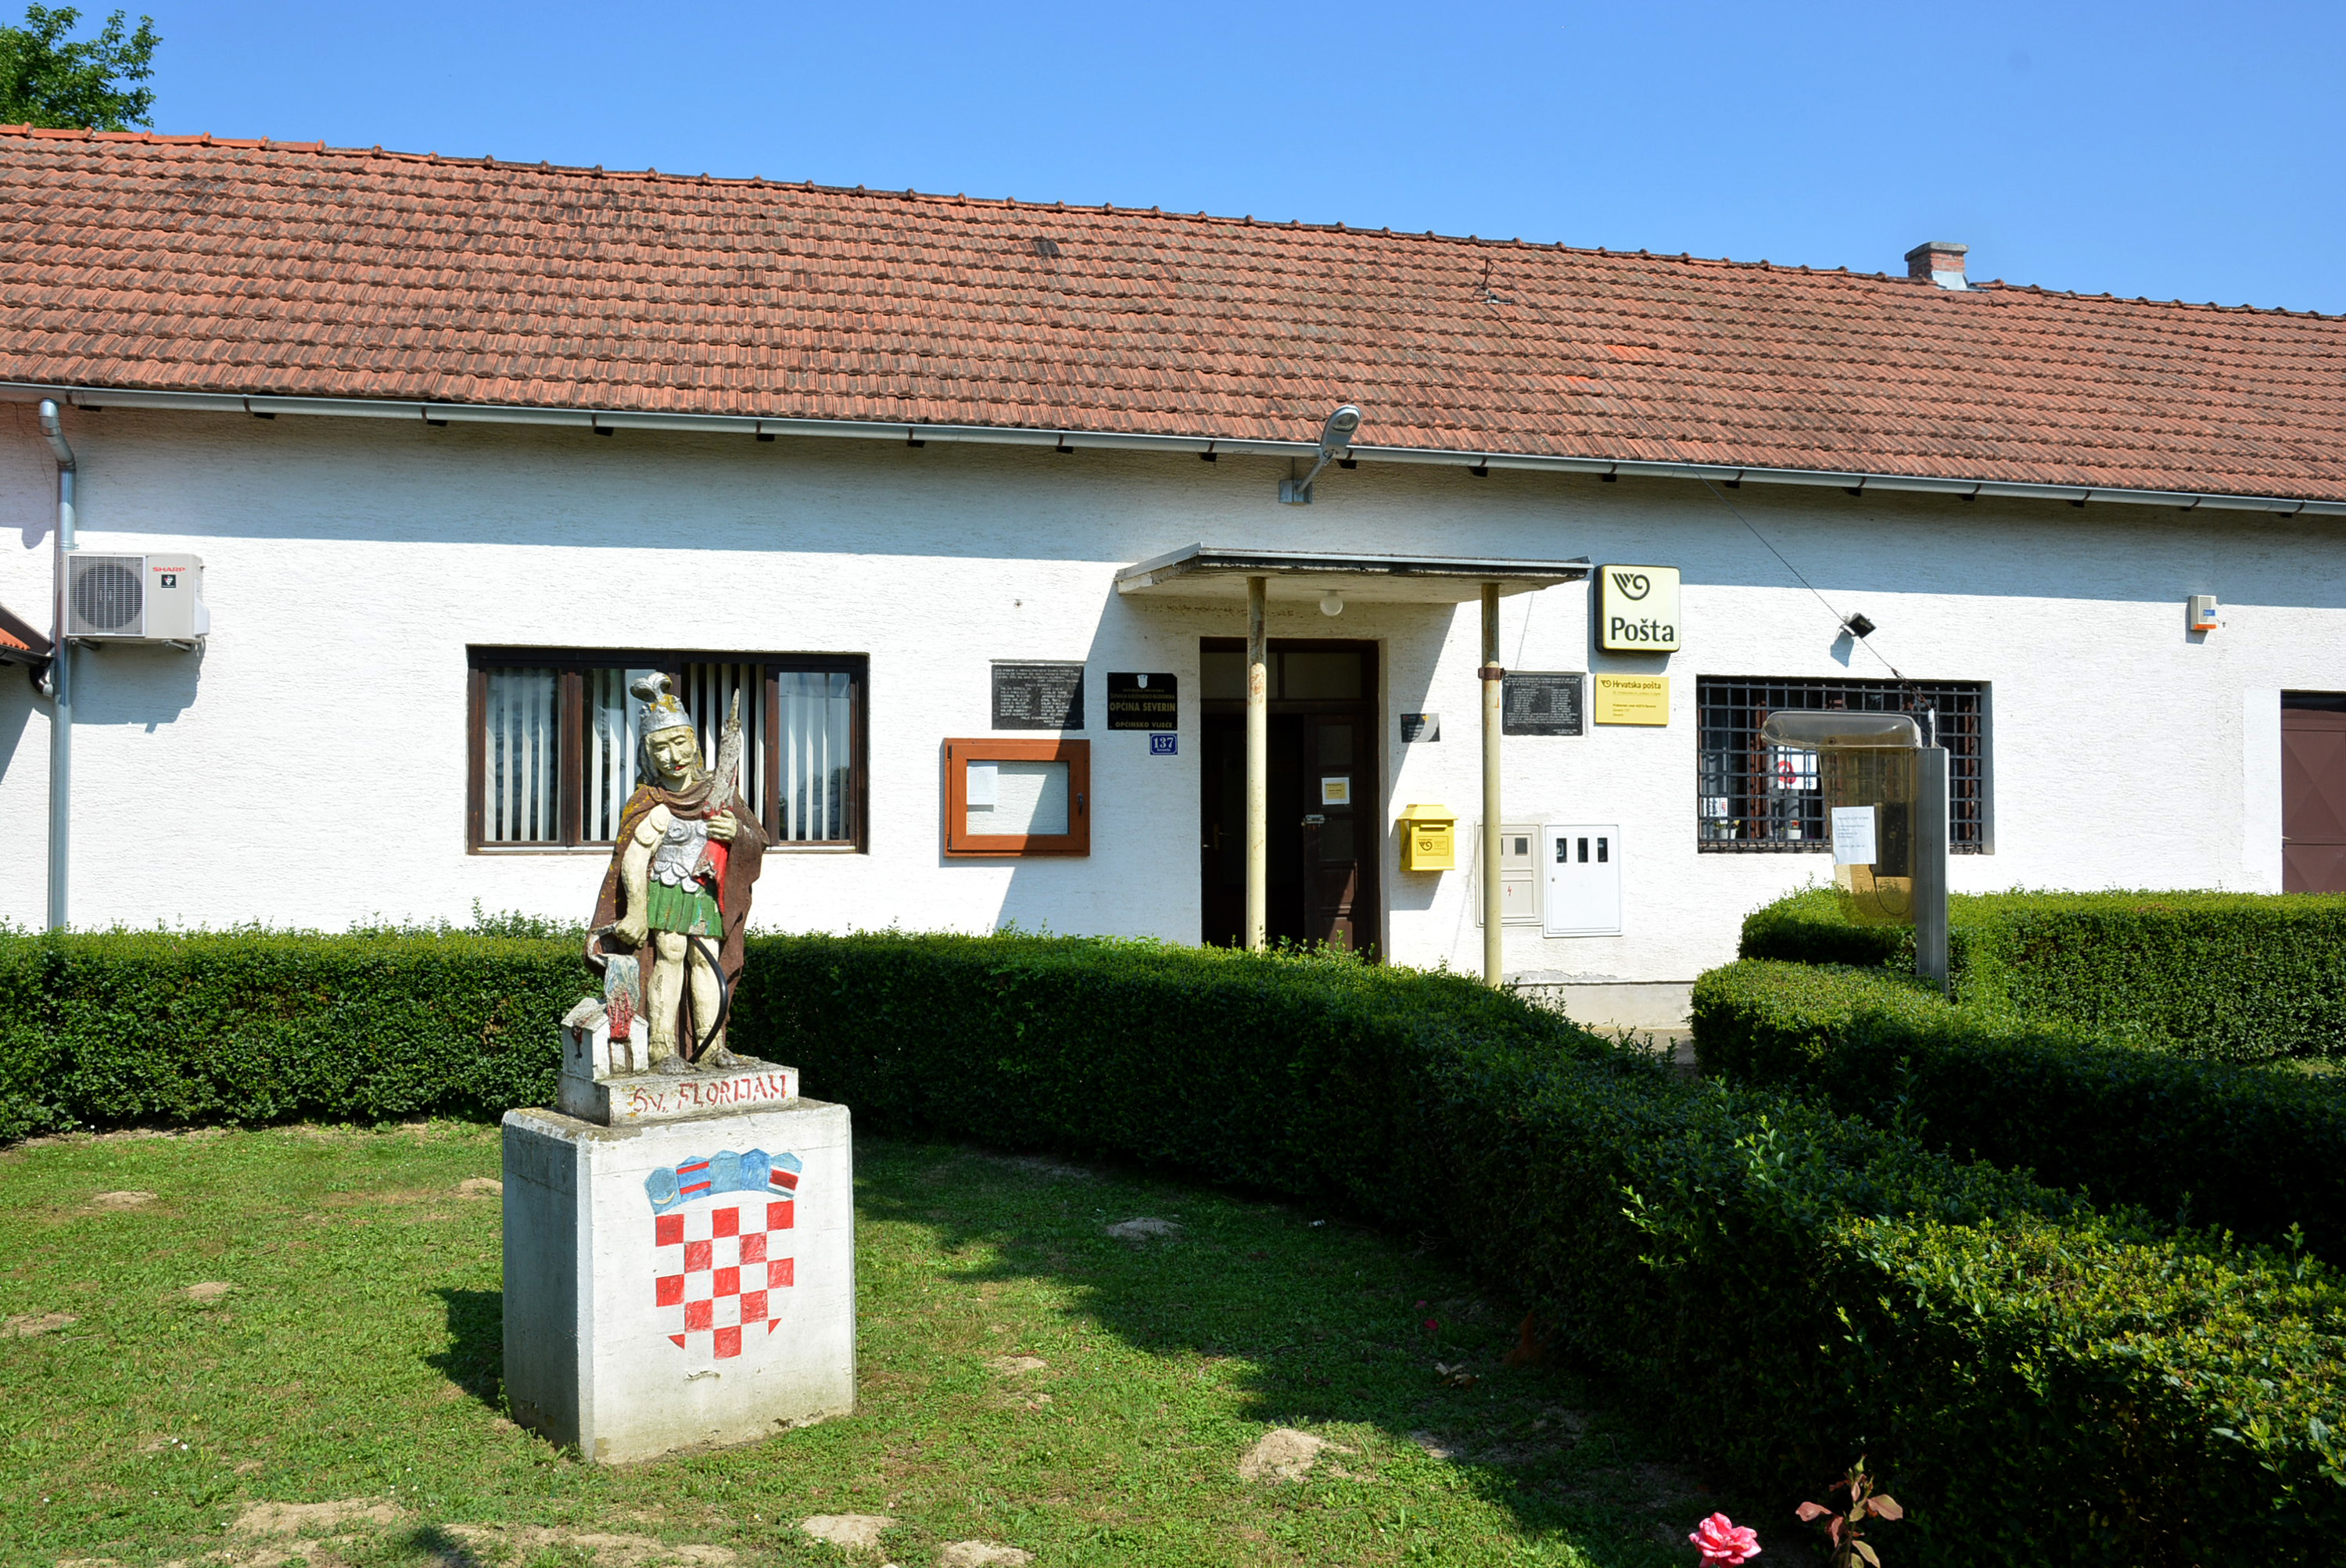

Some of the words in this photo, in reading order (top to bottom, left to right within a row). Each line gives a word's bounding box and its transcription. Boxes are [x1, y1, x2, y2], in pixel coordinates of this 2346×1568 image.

[1611, 617, 1675, 642] Pošta
[1612, 680, 1641, 689] Hrvatska
[1642, 681, 1662, 690] pošta
[1109, 700, 1141, 712] OPĆINA
[1143, 701, 1176, 712] SEVERIN
[1115, 719, 1150, 728] OPĆINSKO
[1151, 719, 1173, 728] VIJEĆE
[1153, 737, 1174, 748] 137
